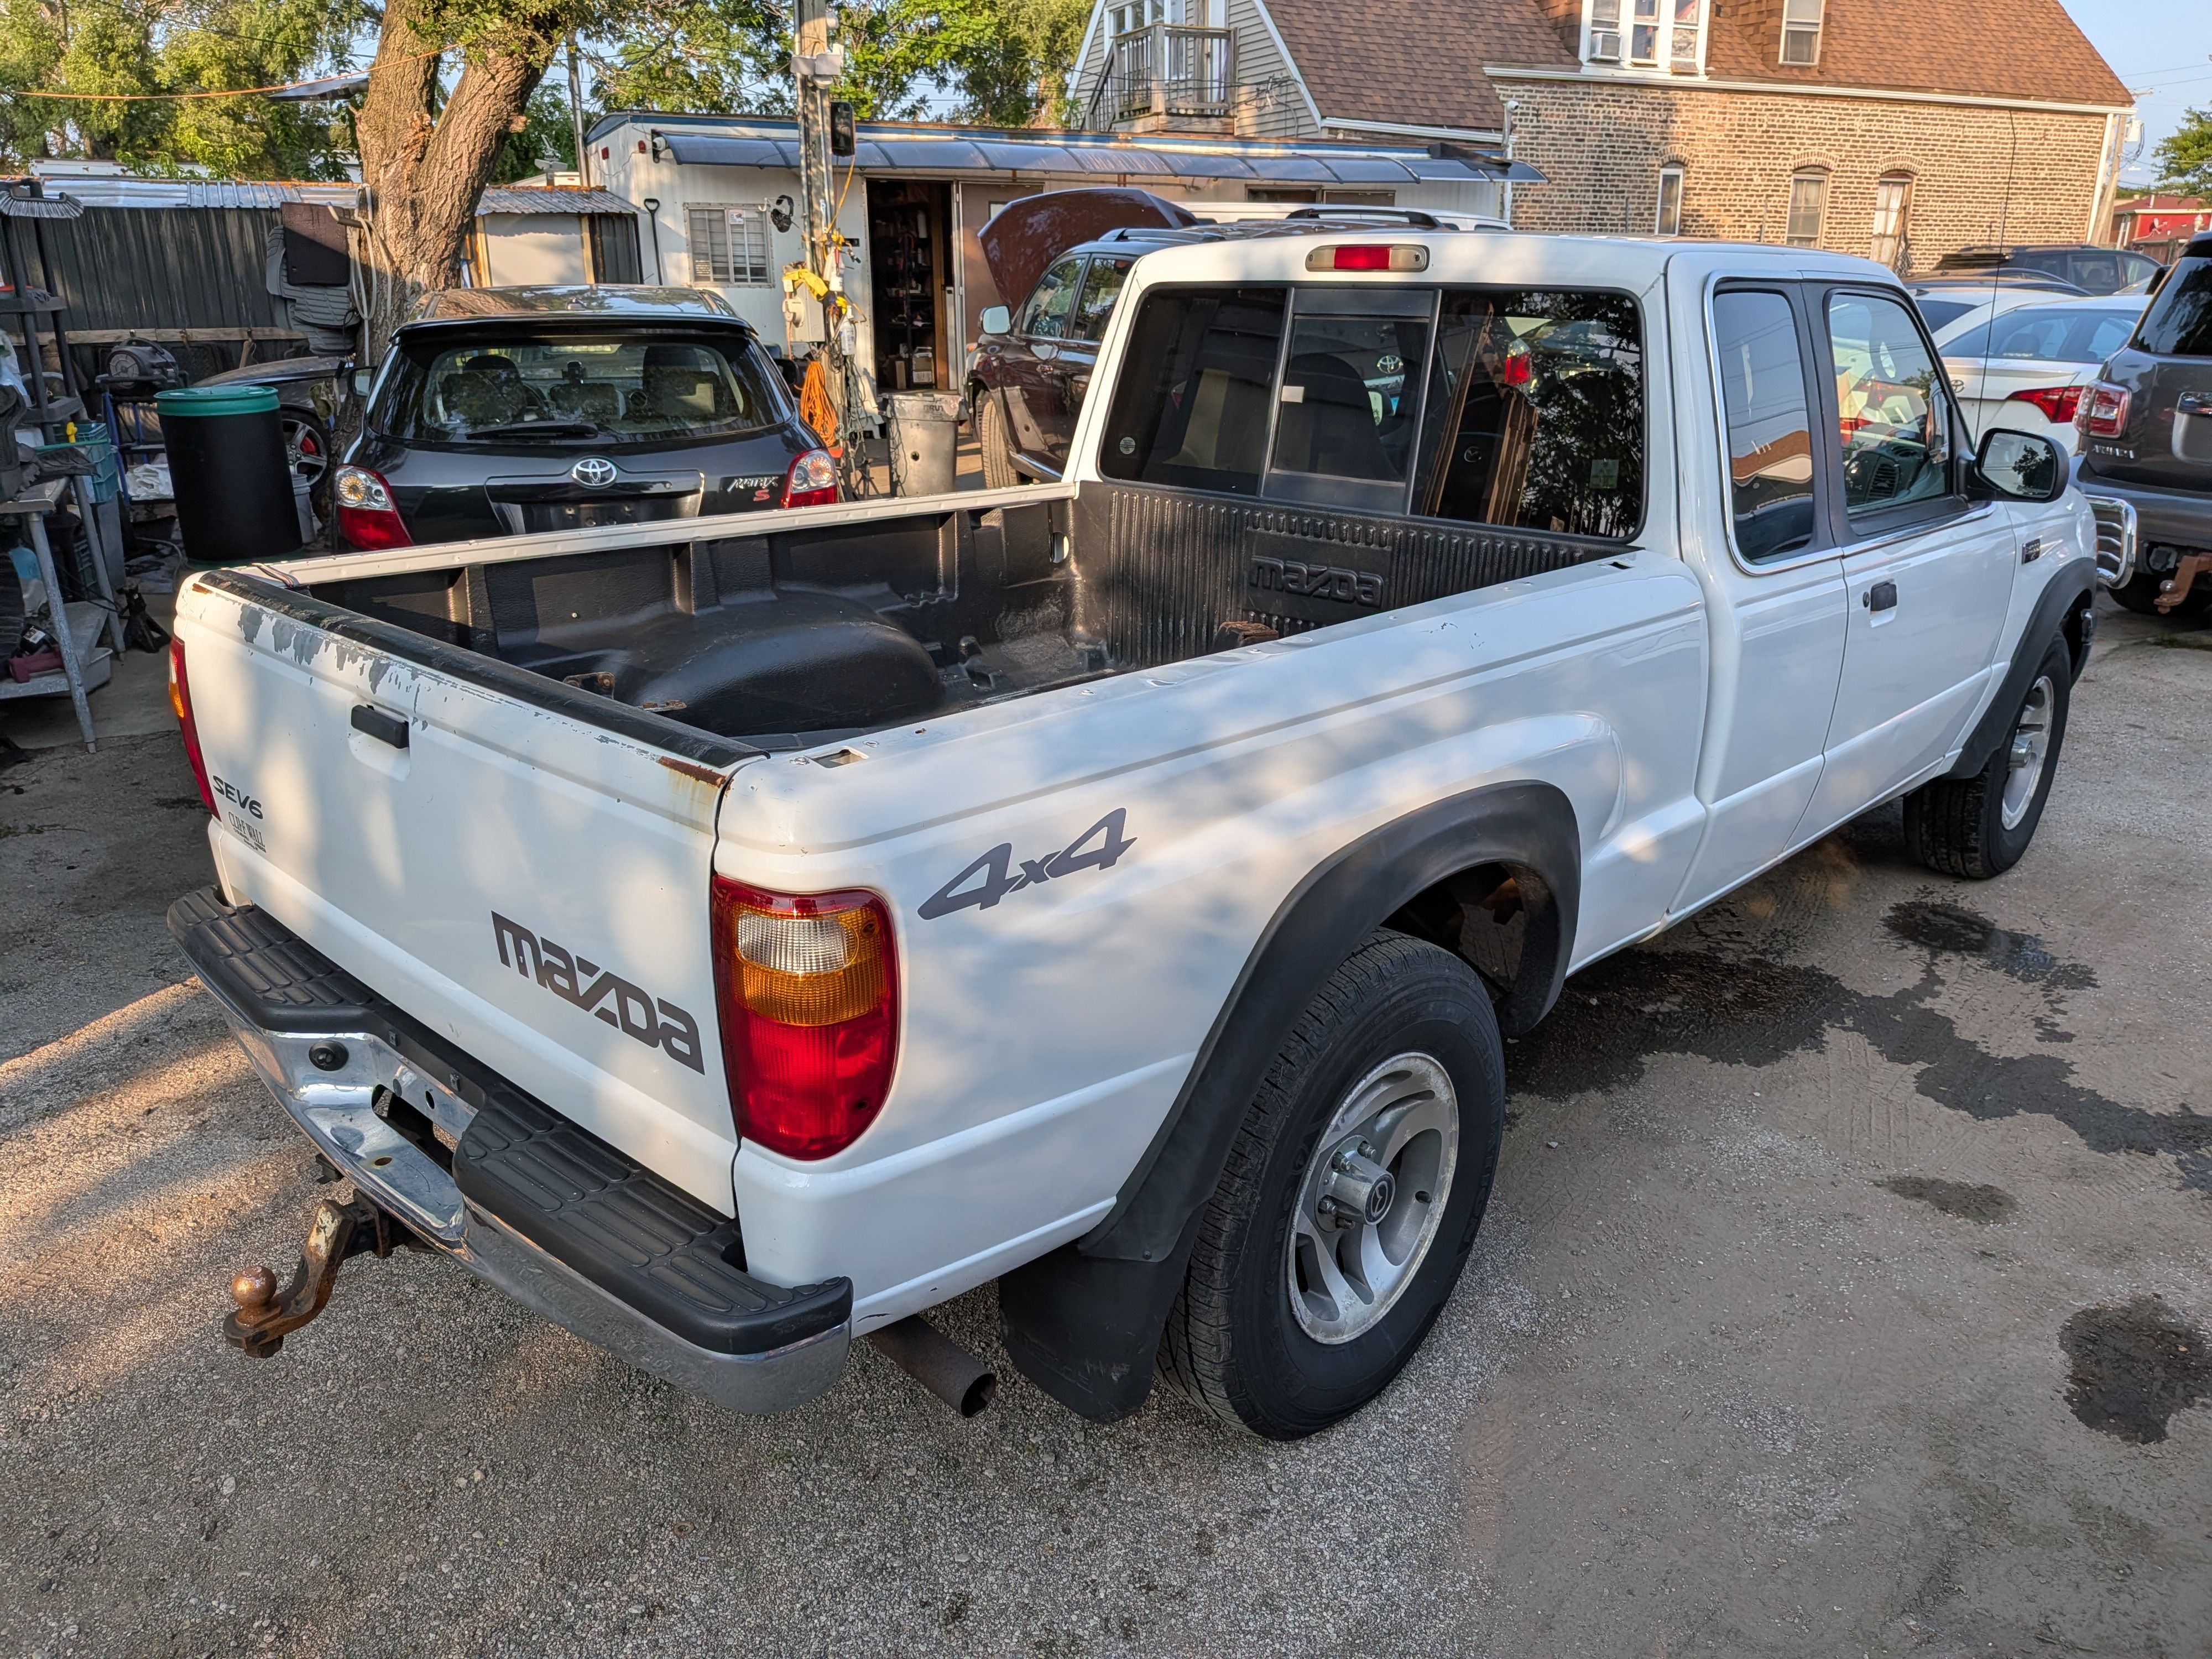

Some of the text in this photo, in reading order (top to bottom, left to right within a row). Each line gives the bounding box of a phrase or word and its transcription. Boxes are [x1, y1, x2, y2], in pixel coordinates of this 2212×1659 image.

[727, 476, 779, 492] MATRIX
[753, 489, 770, 502] S
[245, 822, 266, 848] WALL
[917, 808, 1138, 920] 4x4
